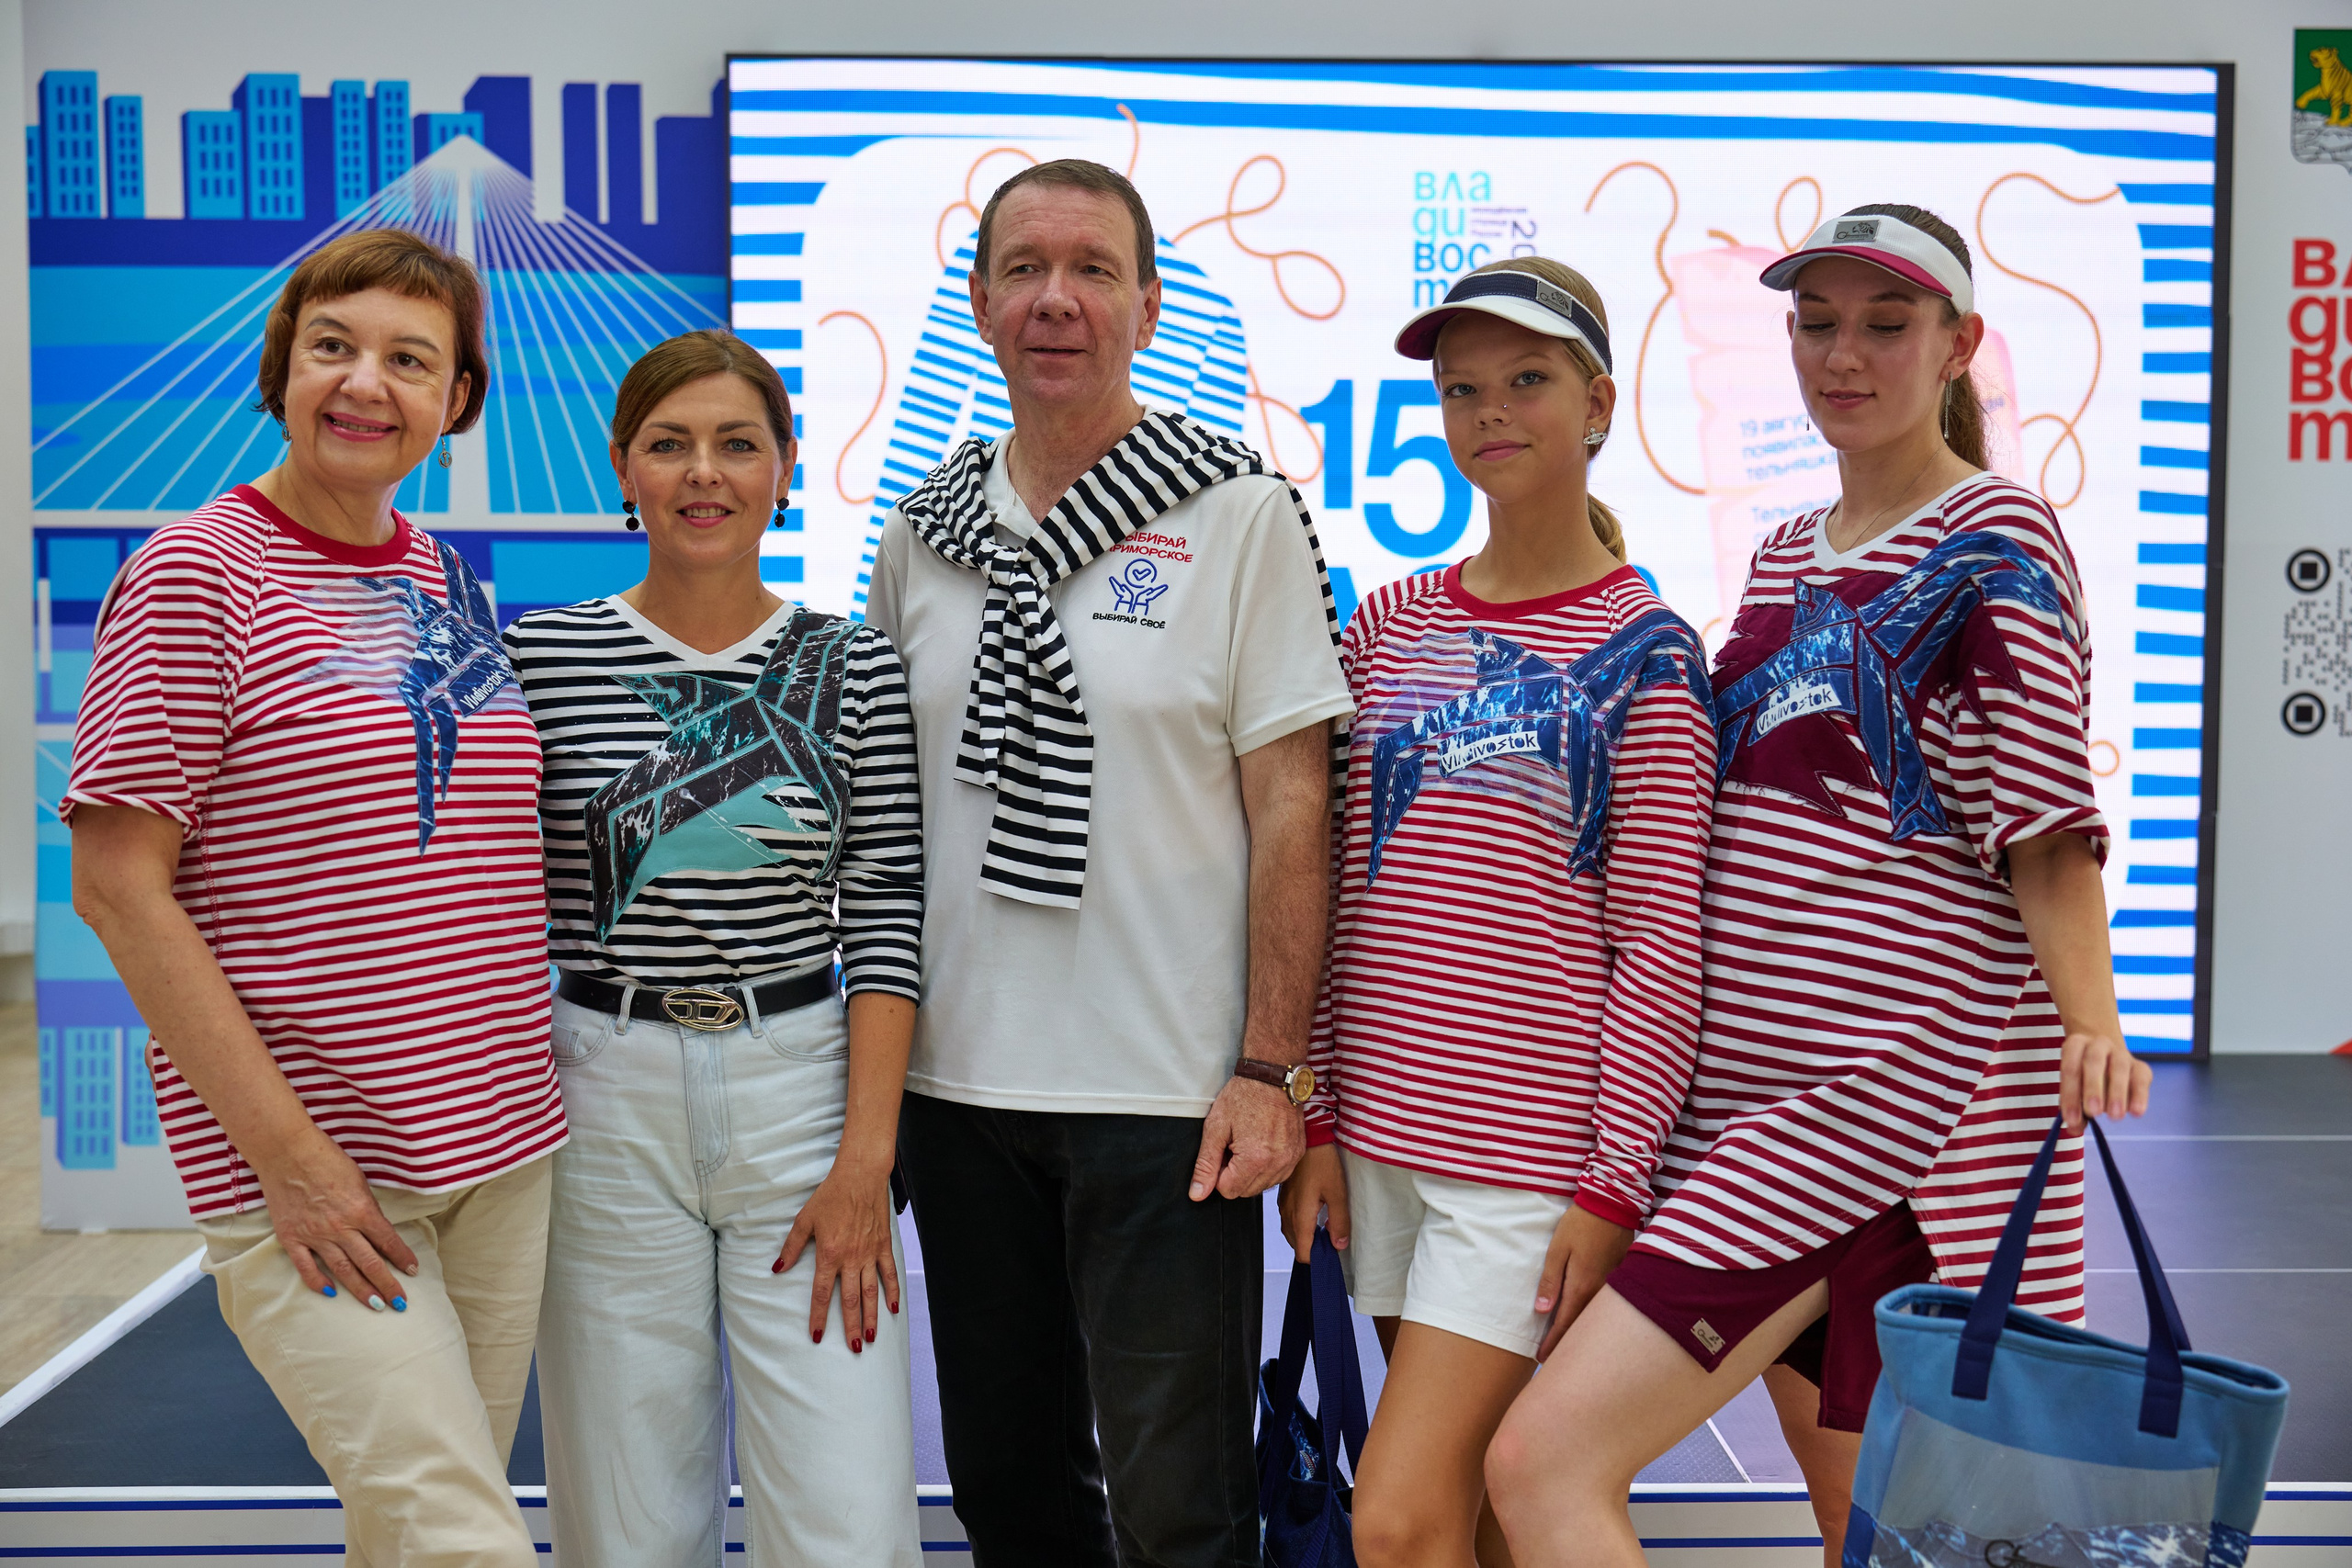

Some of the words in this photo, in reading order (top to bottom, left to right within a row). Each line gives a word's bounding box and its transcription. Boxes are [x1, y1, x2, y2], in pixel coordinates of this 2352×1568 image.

[1300, 378, 1474, 558] 15
[1125, 531, 1187, 549] ЫБИРАЙ
[1092, 612, 1138, 625] ВЫБИРАЙ
